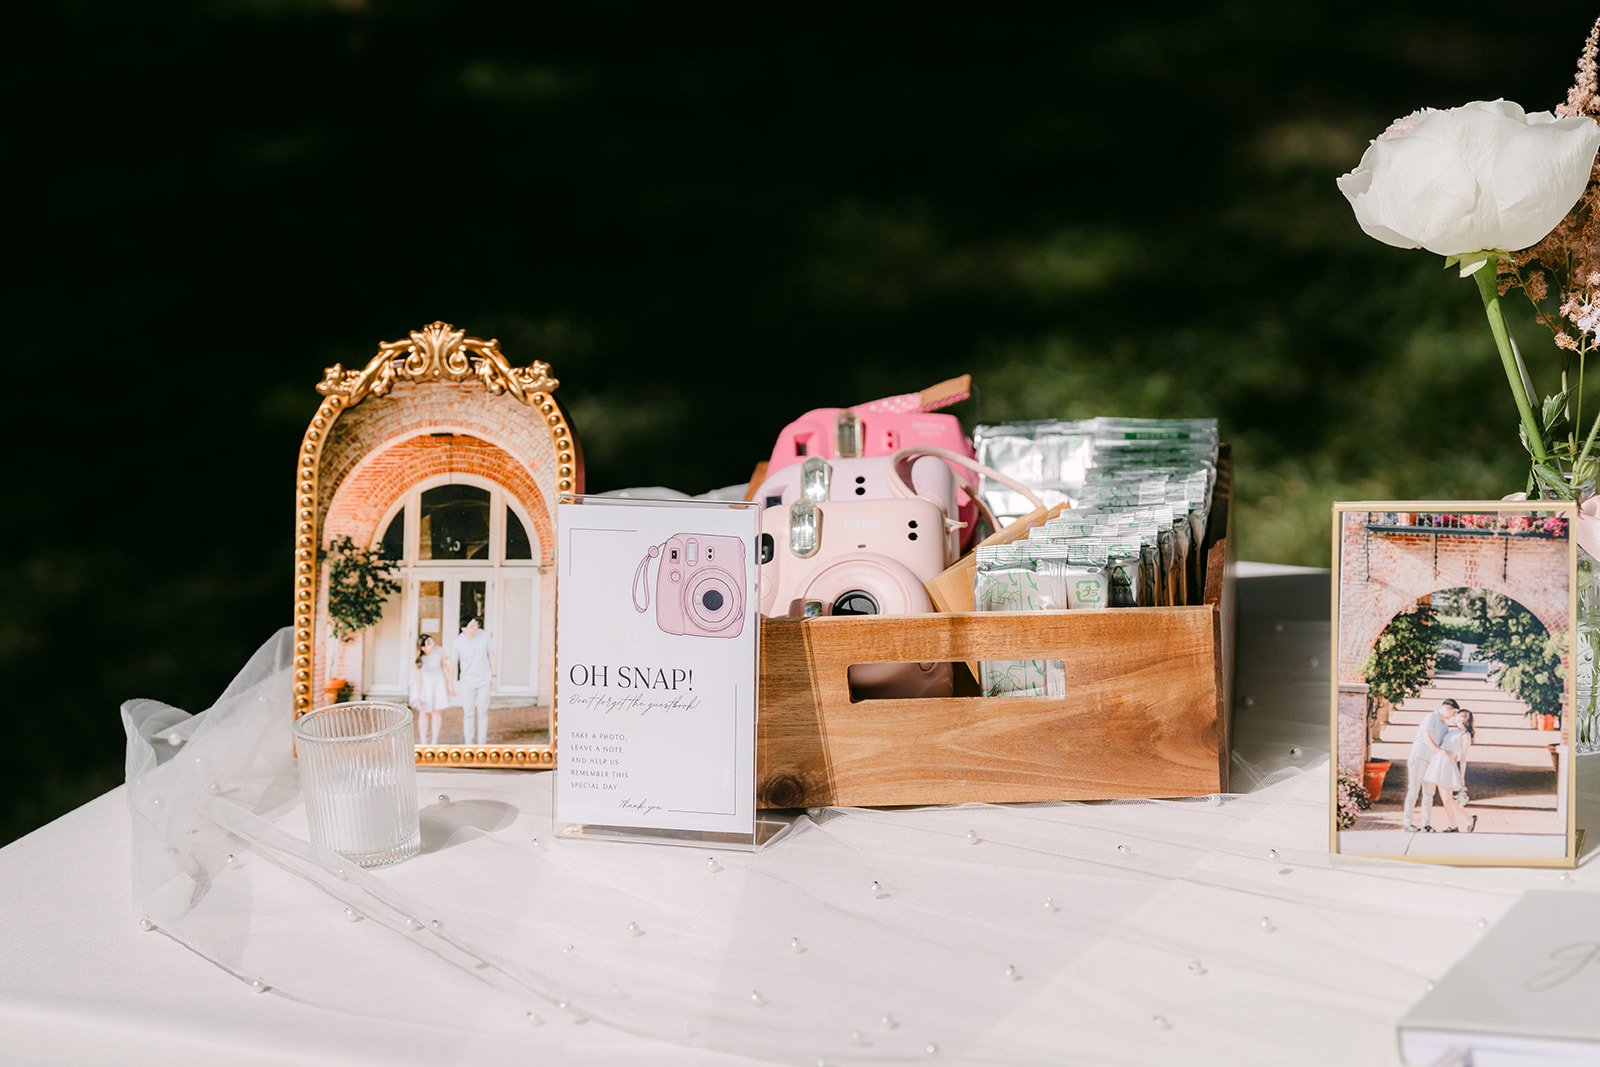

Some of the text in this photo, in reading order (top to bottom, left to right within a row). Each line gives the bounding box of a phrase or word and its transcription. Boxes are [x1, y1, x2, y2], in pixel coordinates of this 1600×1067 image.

[569, 663, 693, 691] OH SNAP!
[593, 694, 630, 714] forget
[626, 693, 645, 711] the
[571, 731, 588, 740] TAKE
[591, 732, 597, 740] A
[570, 744, 592, 752] LEAVE
[570, 769, 629, 779] REMEMBER THIS
[570, 782, 618, 791] SPECIAL DAY
[618, 798, 663, 816] Thank you
